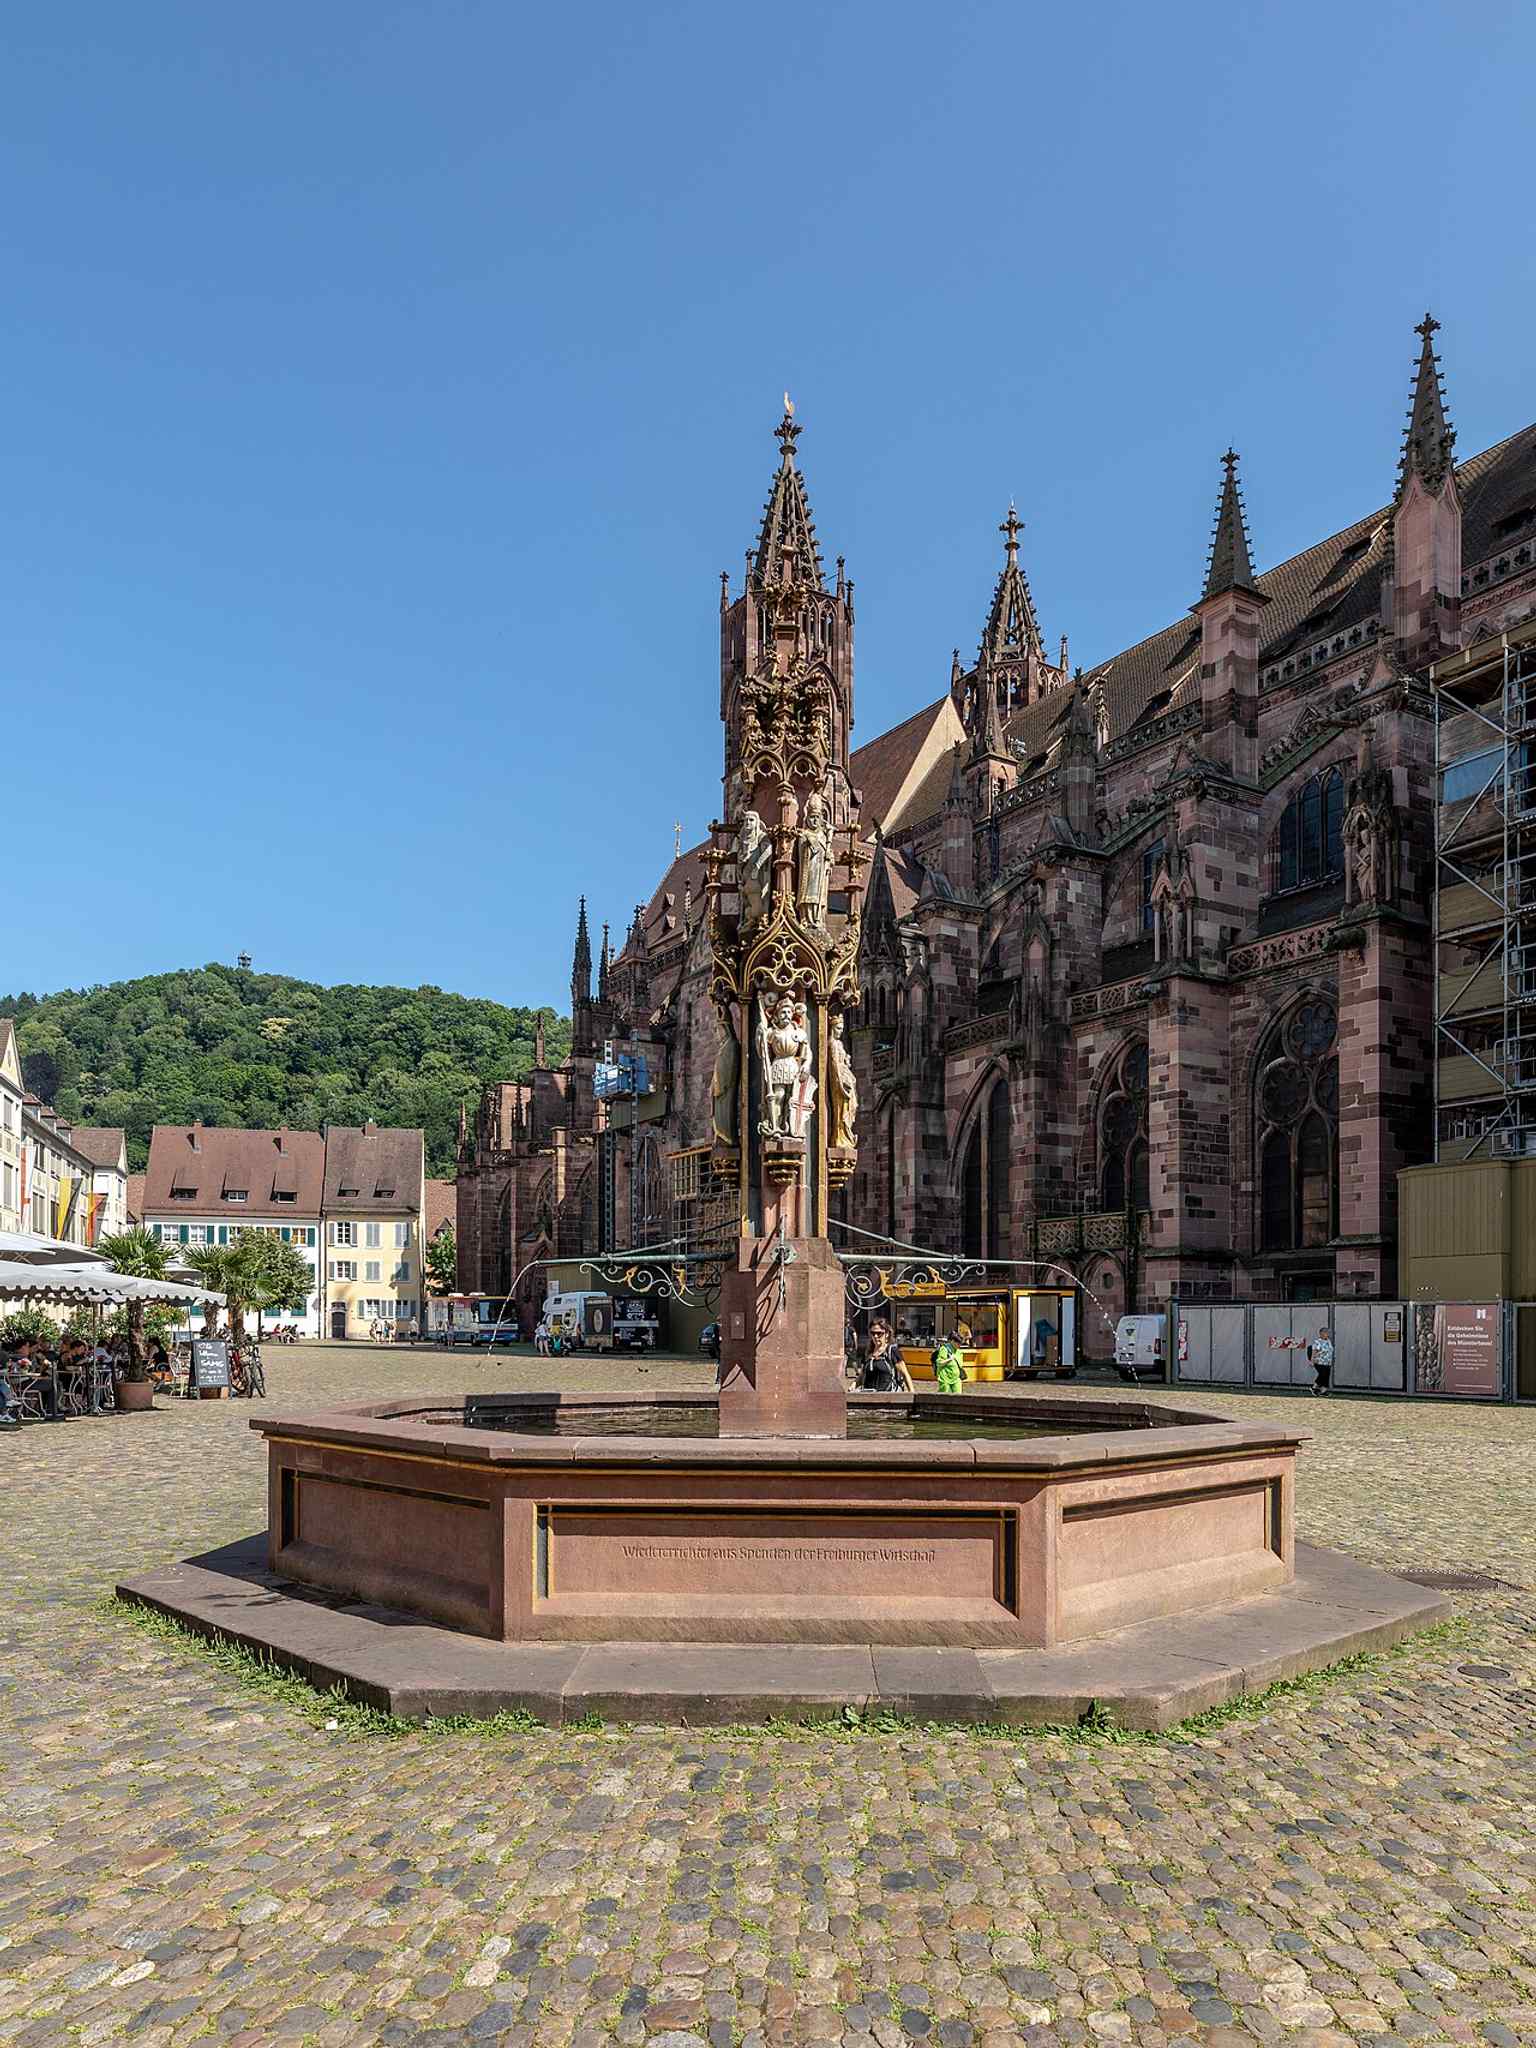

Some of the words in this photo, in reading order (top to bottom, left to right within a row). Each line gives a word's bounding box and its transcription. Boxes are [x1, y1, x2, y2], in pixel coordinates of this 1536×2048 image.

[713, 1548, 737, 1560] aus
[739, 1546, 790, 1561] Spenden
[793, 1547, 816, 1561] der
[816, 1547, 878, 1563] Freiburger
[879, 1548, 936, 1563] Wirtschaft
